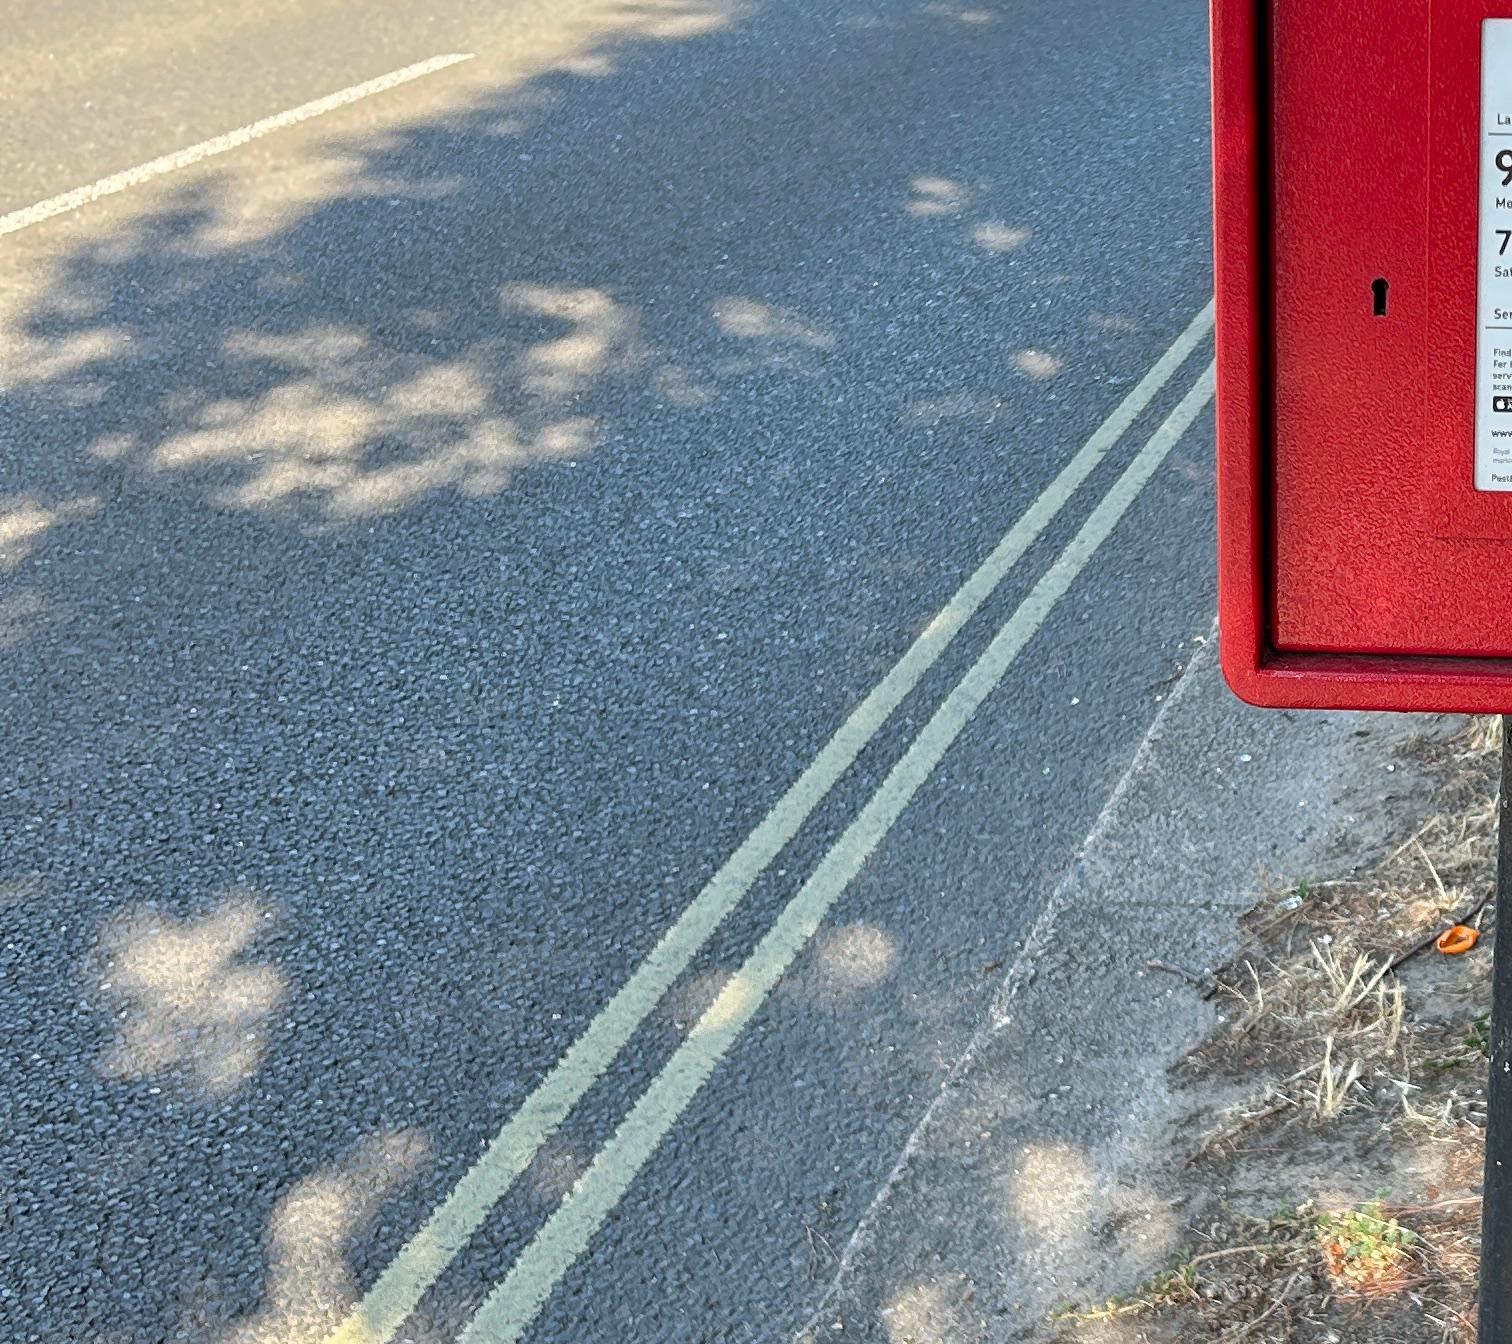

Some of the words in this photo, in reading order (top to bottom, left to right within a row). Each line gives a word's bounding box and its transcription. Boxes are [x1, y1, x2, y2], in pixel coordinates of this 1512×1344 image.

[1493, 348, 1512, 358] Find
[1493, 359, 1507, 369] For
[1492, 384, 1512, 392] scan
